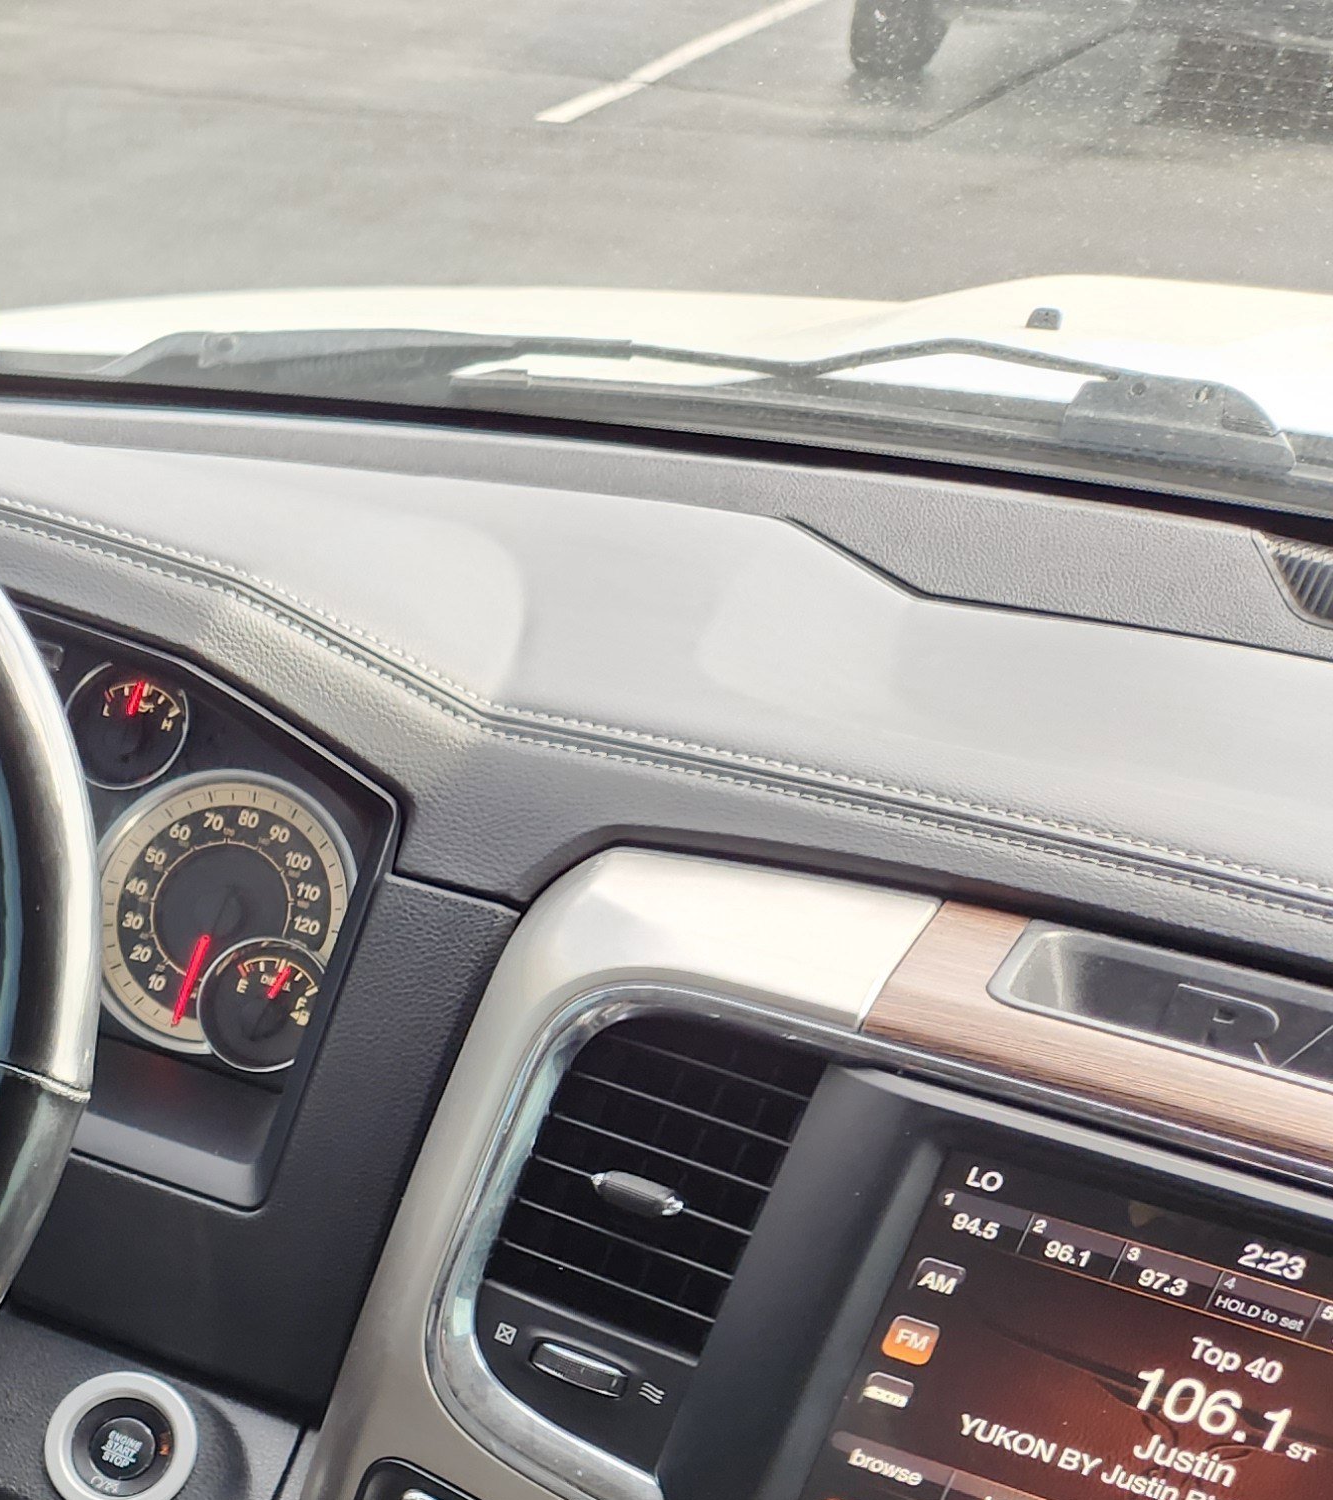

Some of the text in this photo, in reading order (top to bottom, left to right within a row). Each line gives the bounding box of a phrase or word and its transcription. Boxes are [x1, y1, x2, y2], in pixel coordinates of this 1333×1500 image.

[203, 811, 225, 831] 70
[237, 808, 260, 829] 80
[169, 821, 192, 841] 60
[269, 824, 291, 843] 90
[144, 845, 167, 866] 50
[285, 850, 312, 871] 100
[125, 876, 149, 896] 40
[296, 881, 322, 901] 110
[121, 911, 145, 931] 30
[294, 914, 321, 935] 120
[128, 943, 153, 964] 20
[147, 972, 168, 993] 10
[236, 978, 250, 995] E
[295, 996, 309, 1010] F
[965, 1165, 1004, 1193] LO
[943, 1192, 956, 1207] 1
[951, 1213, 1001, 1241] 94.5
[1032, 1219, 1049, 1235] 2
[1043, 1240, 1093, 1268] 96.1
[1126, 1246, 1142, 1262] 3
[1237, 1242, 1308, 1281] 2:23
[917, 1269, 959, 1296] AM
[1137, 1268, 1190, 1298] 97.3
[1223, 1277, 1237, 1291] 4
[1214, 1294, 1305, 1332] HOLD to set
[894, 1326, 931, 1353] FM
[1191, 1335, 1284, 1385] Top 40
[1136, 1367, 1318, 1463] 106.1 ST
[960, 1413, 1063, 1463] YUKON
[1057, 1447, 1103, 1477] BY
[101, 1450, 131, 1468] STOP
[846, 1447, 924, 1488] browse
[1133, 1434, 1238, 1488] Justin
